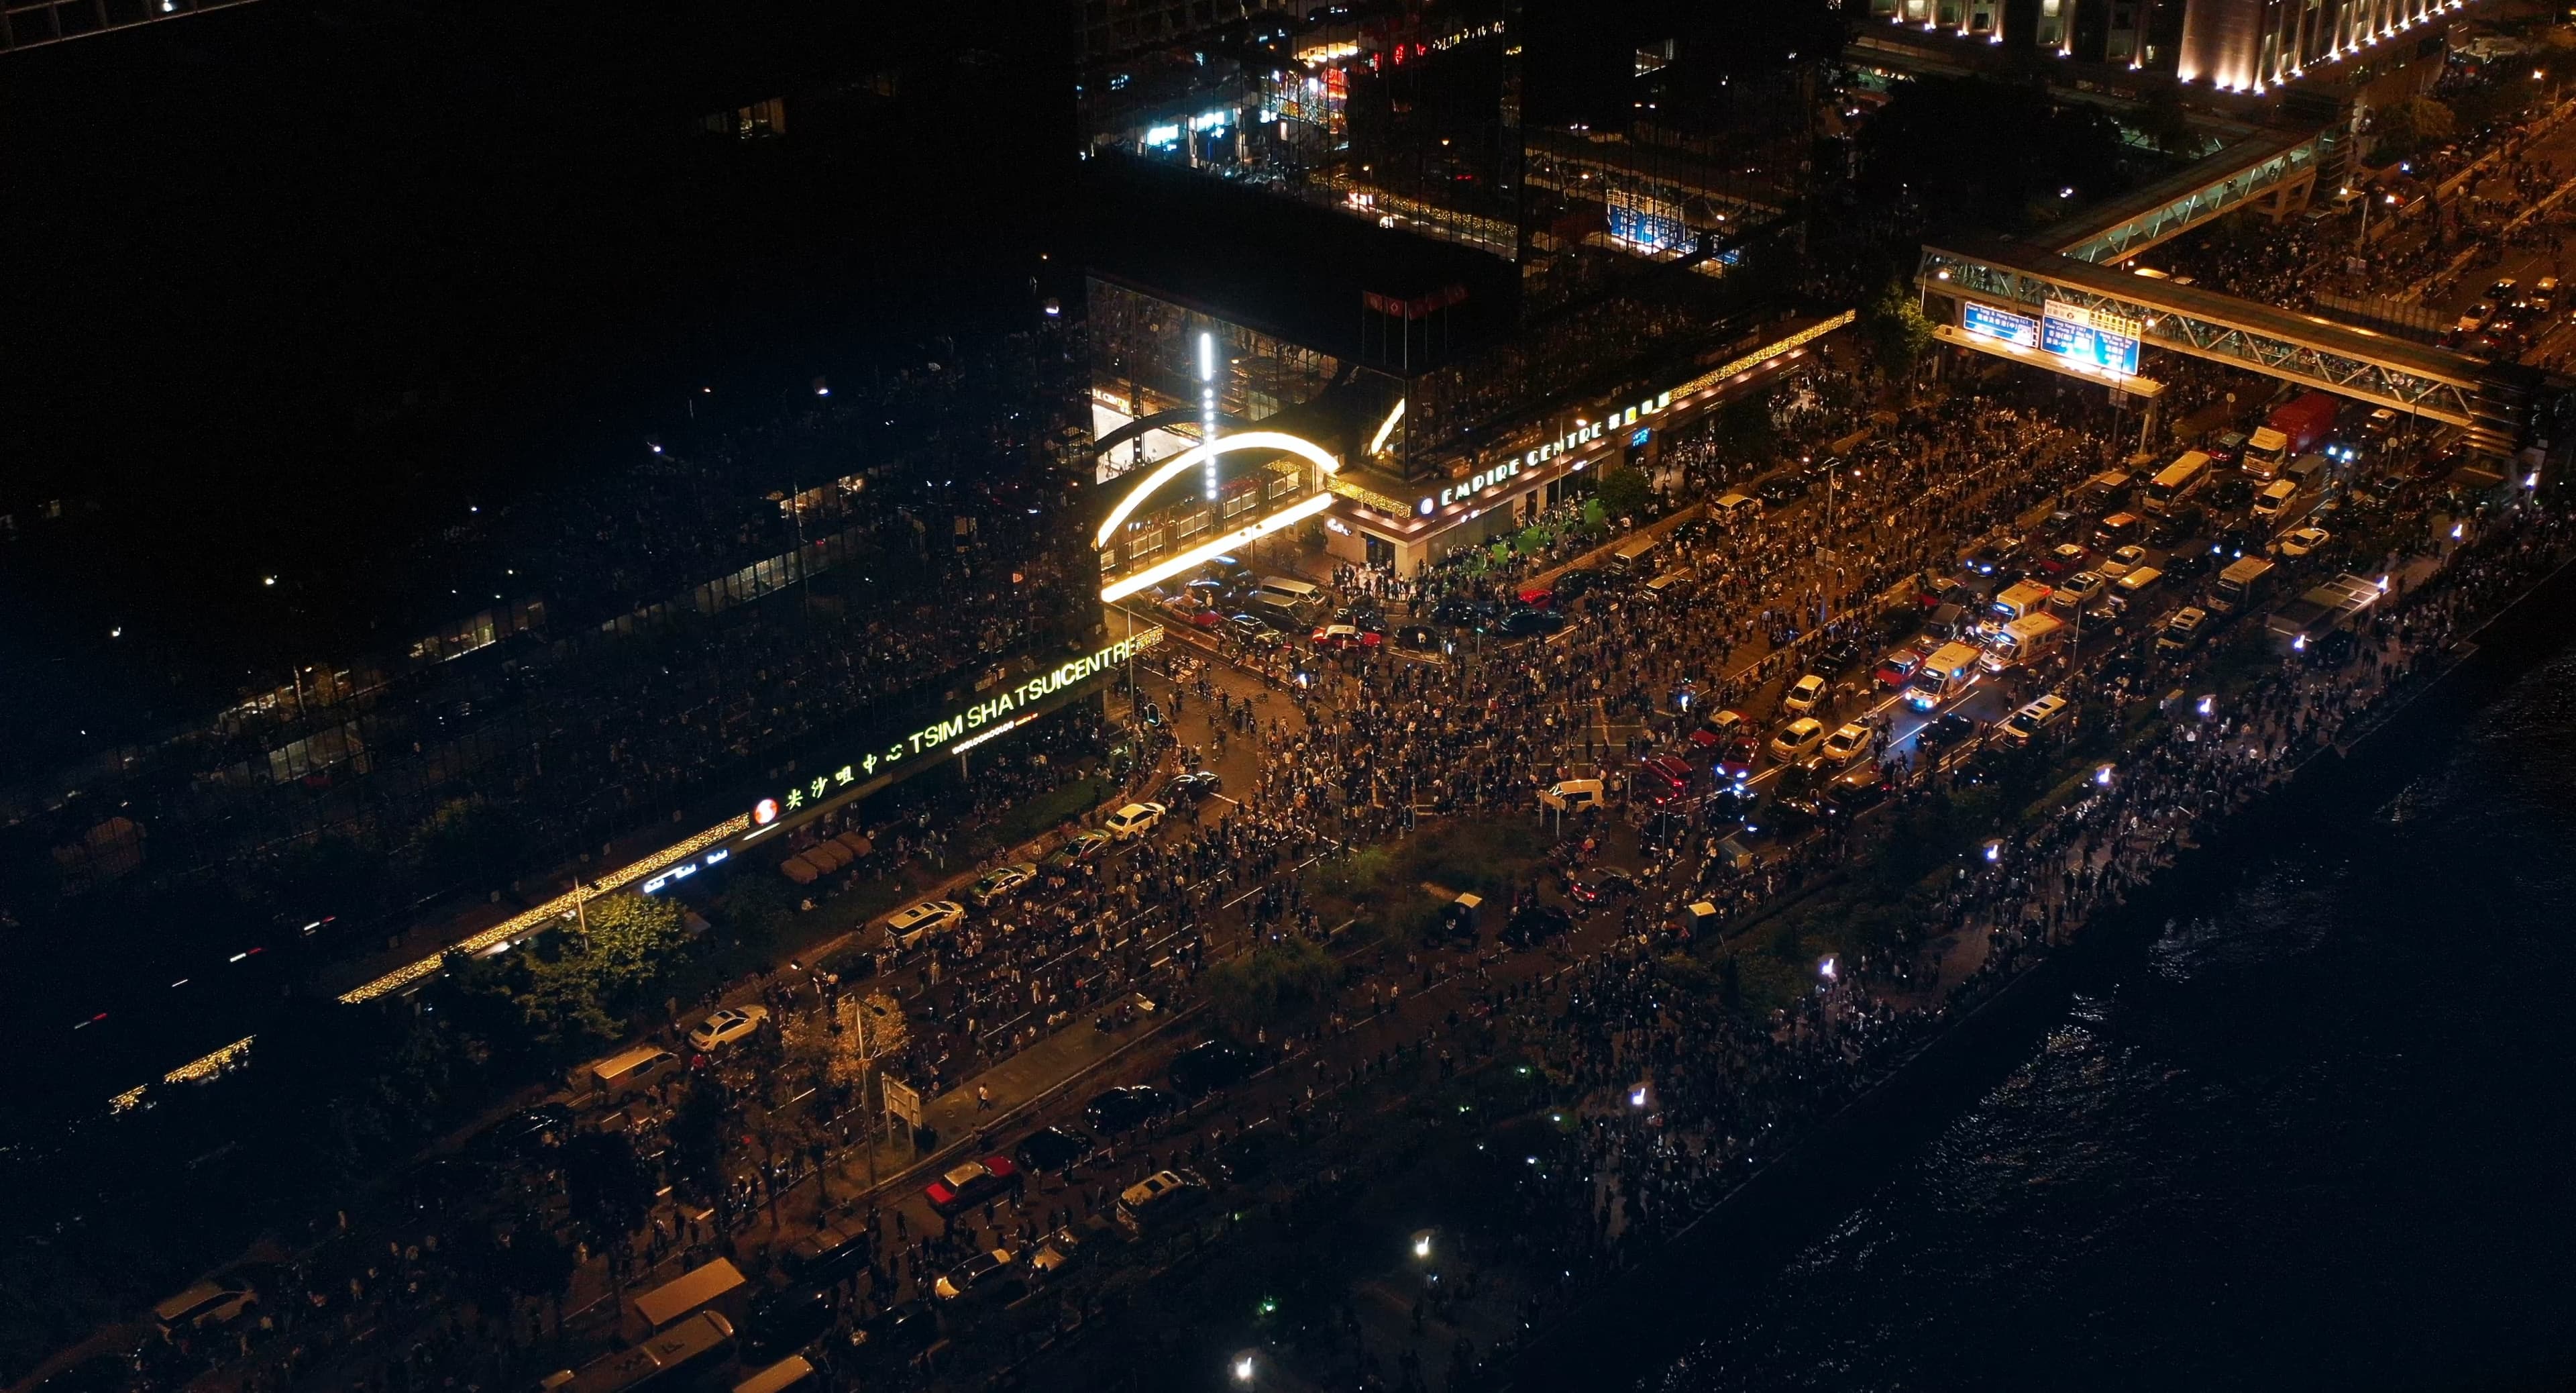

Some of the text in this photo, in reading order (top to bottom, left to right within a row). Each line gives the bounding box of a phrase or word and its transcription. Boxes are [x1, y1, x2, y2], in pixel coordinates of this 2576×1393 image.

[1442, 458, 1519, 506] EMPIRE
[1527, 421, 1602, 466] CENTRE
[909, 714, 963, 754] TSIM
[967, 693, 1014, 728] SHA
[786, 743, 904, 811] 尖沙咀中心
